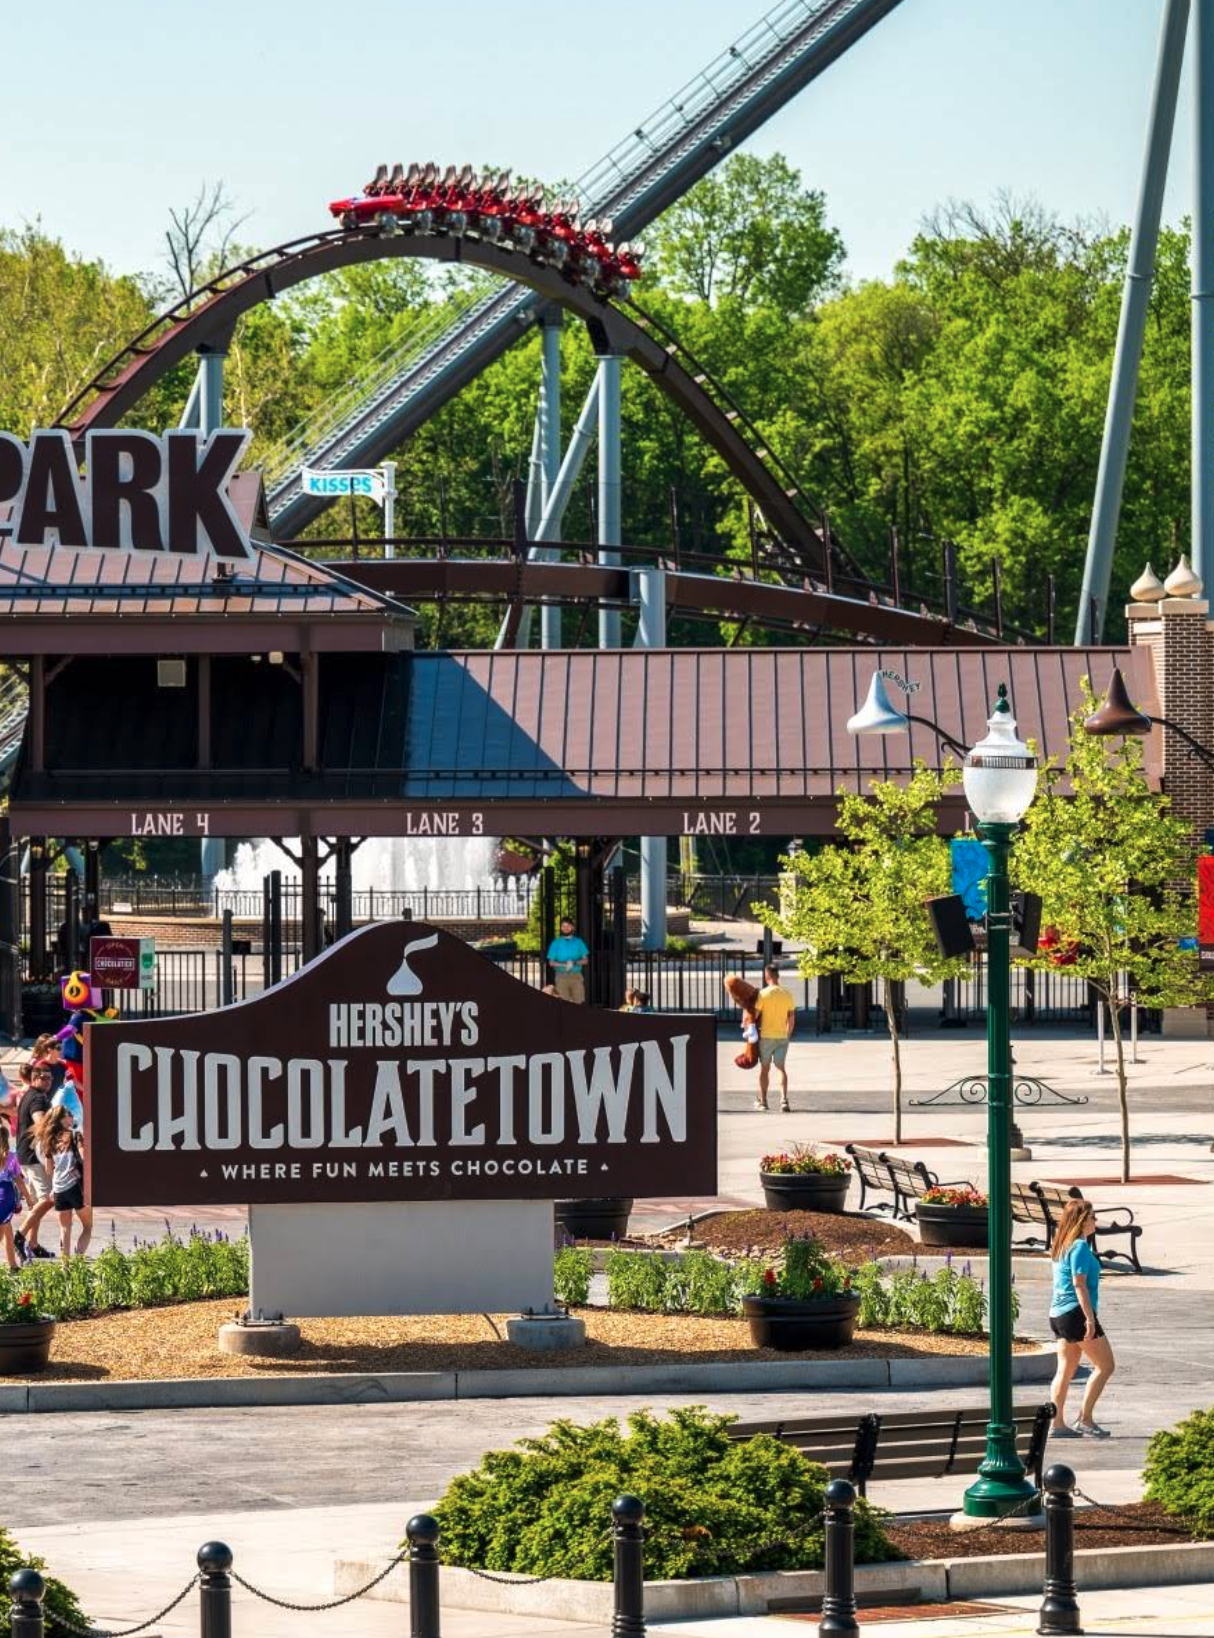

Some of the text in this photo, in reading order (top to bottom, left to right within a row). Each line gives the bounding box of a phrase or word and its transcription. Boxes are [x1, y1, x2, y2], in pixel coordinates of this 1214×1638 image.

[131, 813, 210, 835] LANE 4
[406, 813, 484, 834] LANE 3
[683, 812, 761, 834] LANE 2
[329, 1001, 479, 1048] HERSHEY'S
[117, 1034, 691, 1152] CHOCOLATETOWN
[222, 1158, 589, 1180] WHERE FUN MEETS CHOCOLATE
